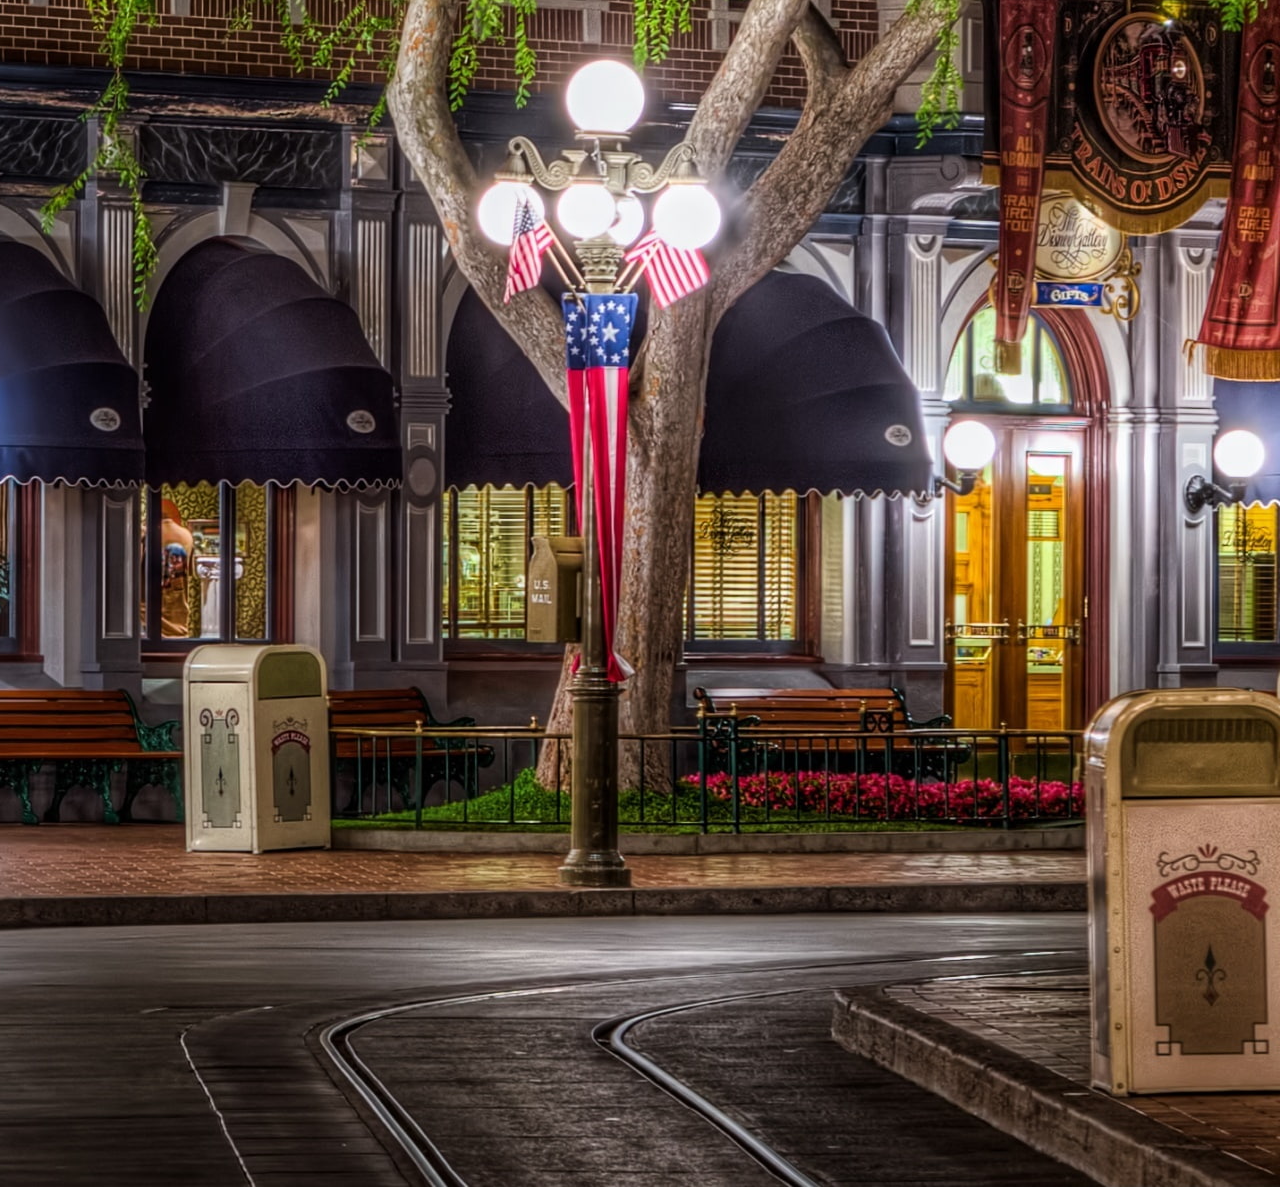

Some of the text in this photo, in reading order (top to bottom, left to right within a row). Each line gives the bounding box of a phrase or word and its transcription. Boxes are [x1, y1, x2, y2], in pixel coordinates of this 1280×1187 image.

[531, 594, 552, 604] MAIL
[1166, 876, 1251, 899] WASTE PLEASE
